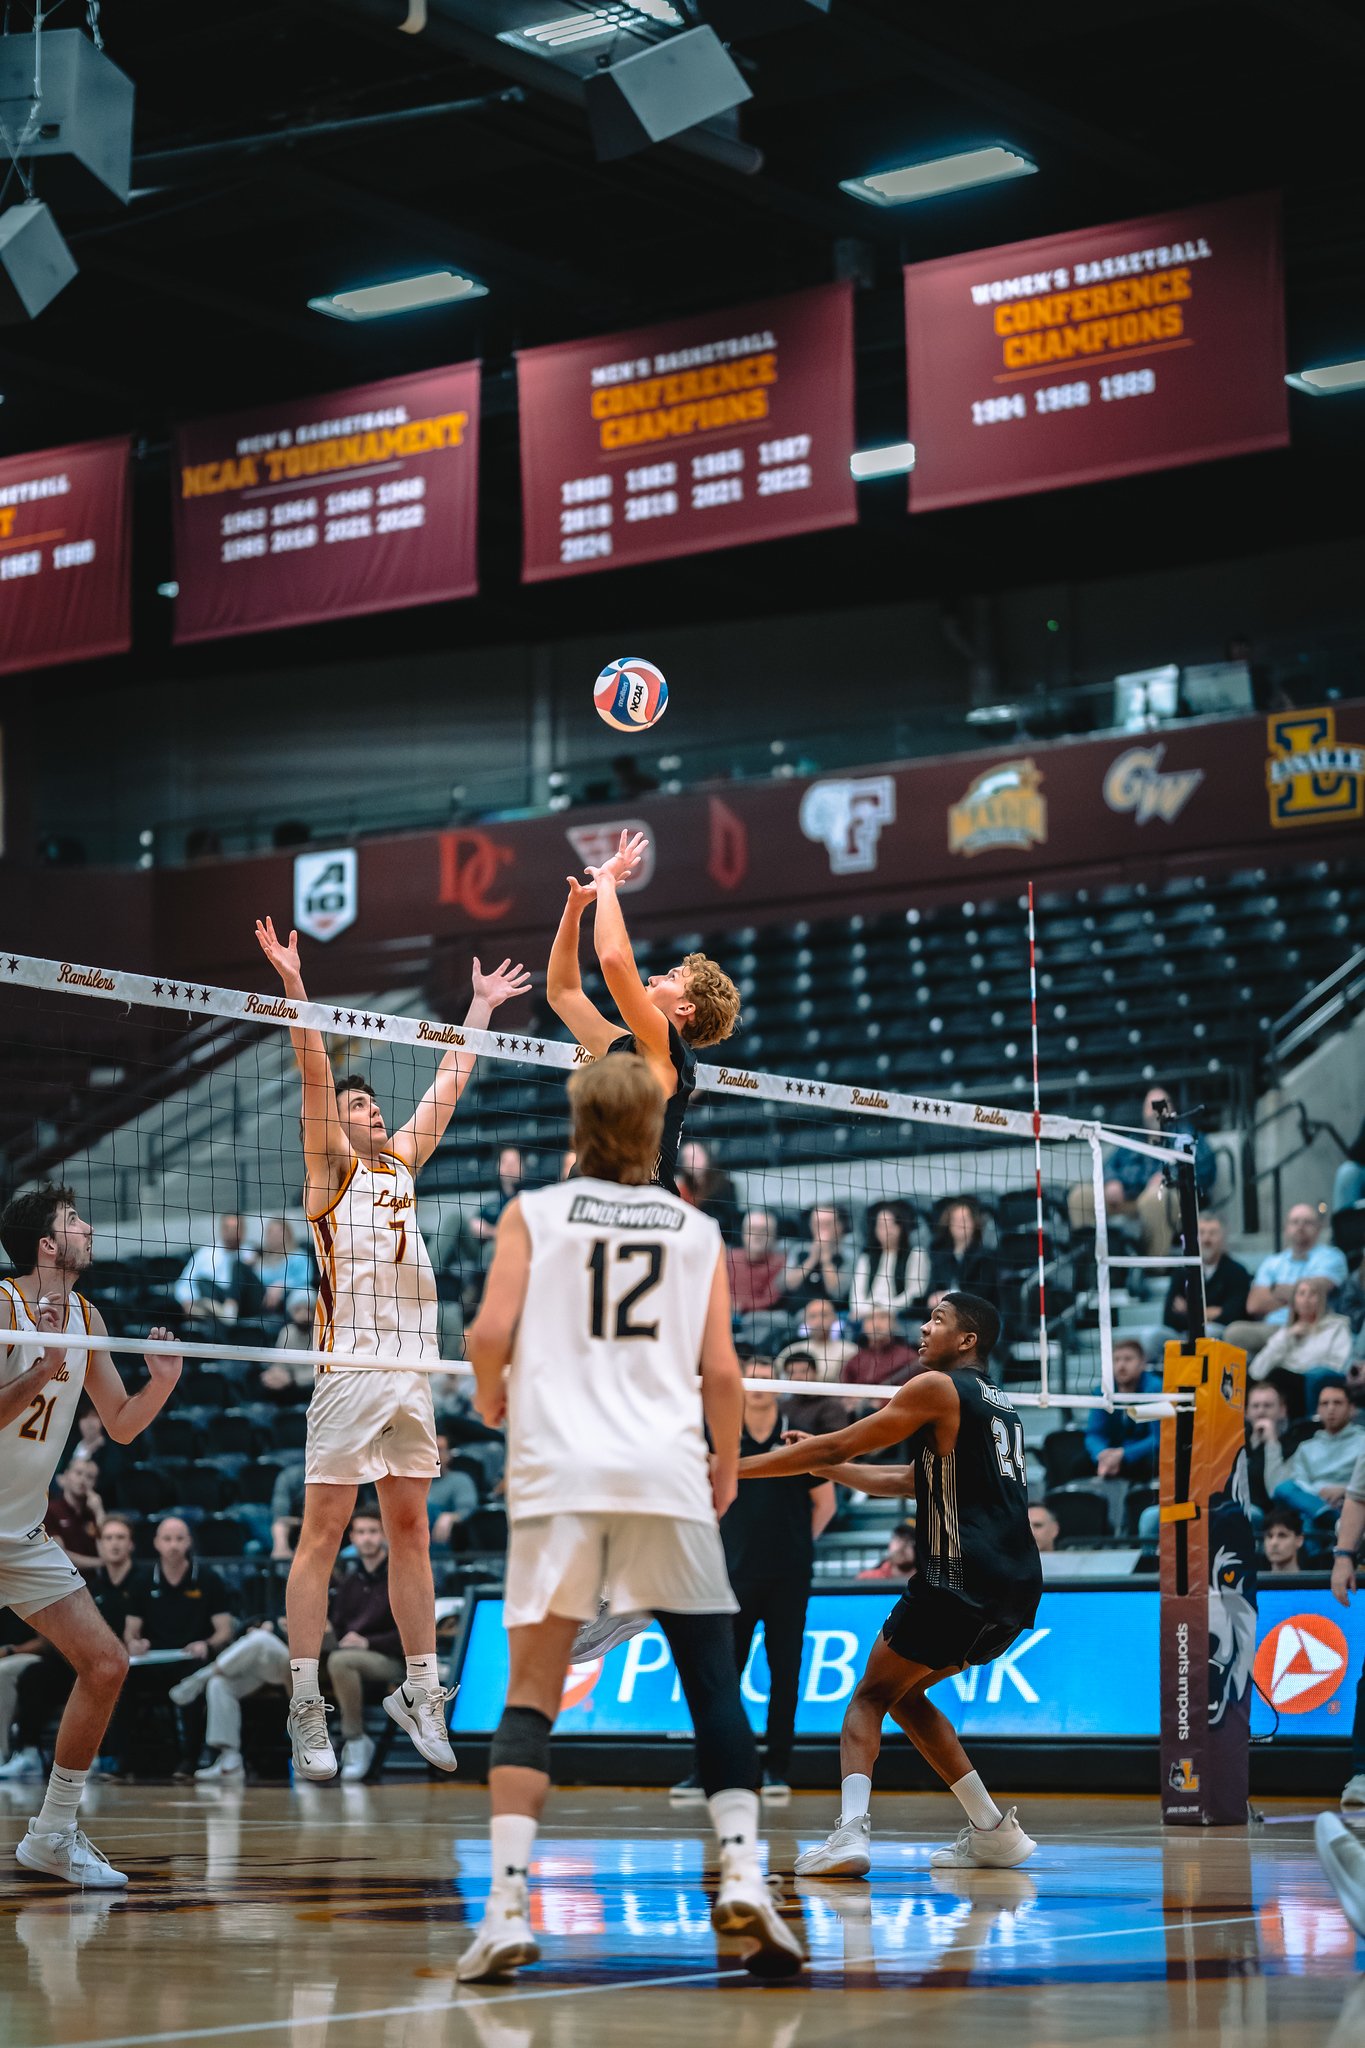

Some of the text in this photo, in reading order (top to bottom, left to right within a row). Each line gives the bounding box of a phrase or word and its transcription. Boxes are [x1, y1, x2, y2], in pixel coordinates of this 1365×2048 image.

[970, 238, 1212, 305] WOMEN'S BASKETBALL
[994, 268, 1192, 336] CONFERENCE
[591, 330, 777, 387] MEN'S BASKETBALL
[1003, 304, 1184, 369] CHAMPIONS
[591, 353, 778, 420] CONFERENCE
[601, 388, 768, 449] CHAMPIONS
[265, 411, 468, 481] TOURNAMENT
[618, 681, 629, 707] molten
[630, 684, 644, 712] NCAA
[57, 963, 115, 991] Ramblers
[243, 994, 298, 1020] Ramblers
[416, 1021, 466, 1046] Ramblers
[717, 1068, 759, 1090] Ramblers
[850, 1088, 889, 1110] Ramblers
[388, 1220, 406, 1264] 7
[586, 1237, 667, 1342] 12
[19, 1394, 57, 1443] 21
